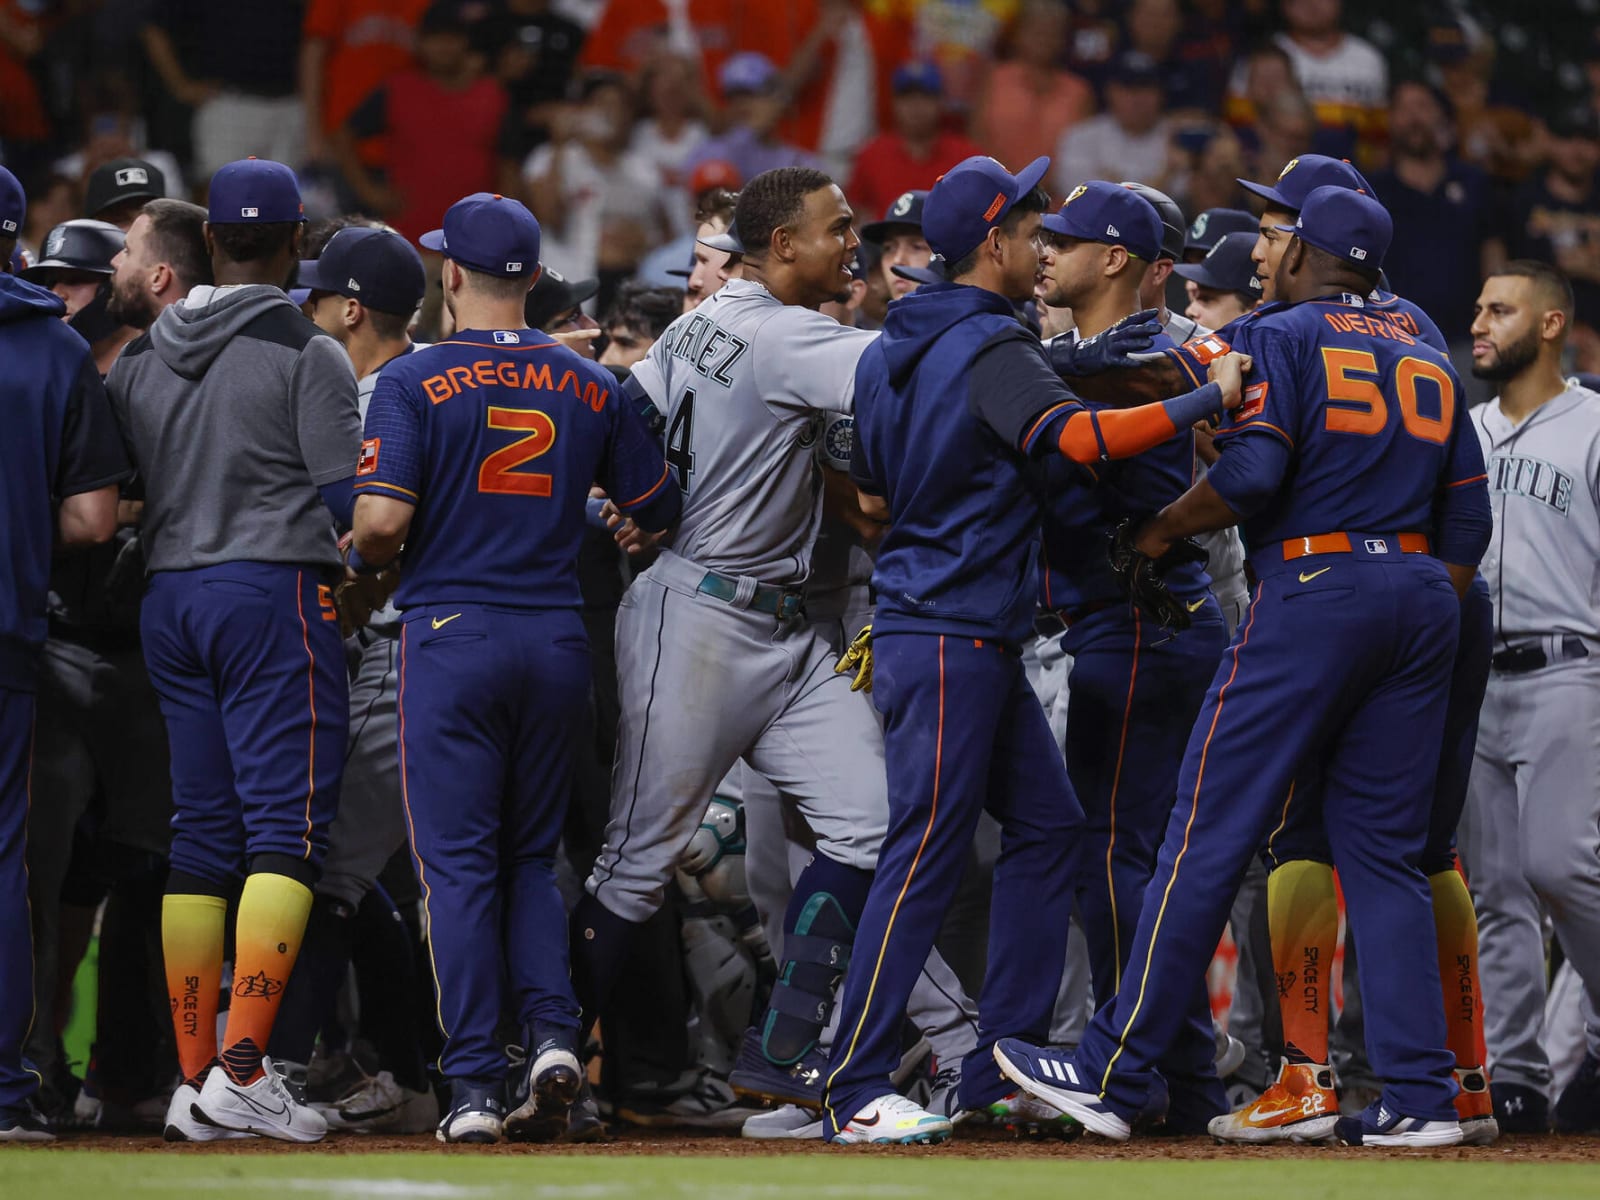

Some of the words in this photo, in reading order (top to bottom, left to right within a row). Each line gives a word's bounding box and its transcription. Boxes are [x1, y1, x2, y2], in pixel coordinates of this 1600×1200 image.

[1324, 311, 1416, 346] NERIS
[421, 360, 609, 412] BREGMAN
[1320, 346, 1455, 445] 50
[478, 406, 556, 497] 2
[1303, 946, 1319, 984] SPACE
[1456, 954, 1472, 993] SPACE
[183, 975, 199, 1010] SPACE
[1303, 986, 1319, 1015] CITY
[183, 1011, 198, 1037] CITY
[1301, 1092, 1326, 1115] 22
